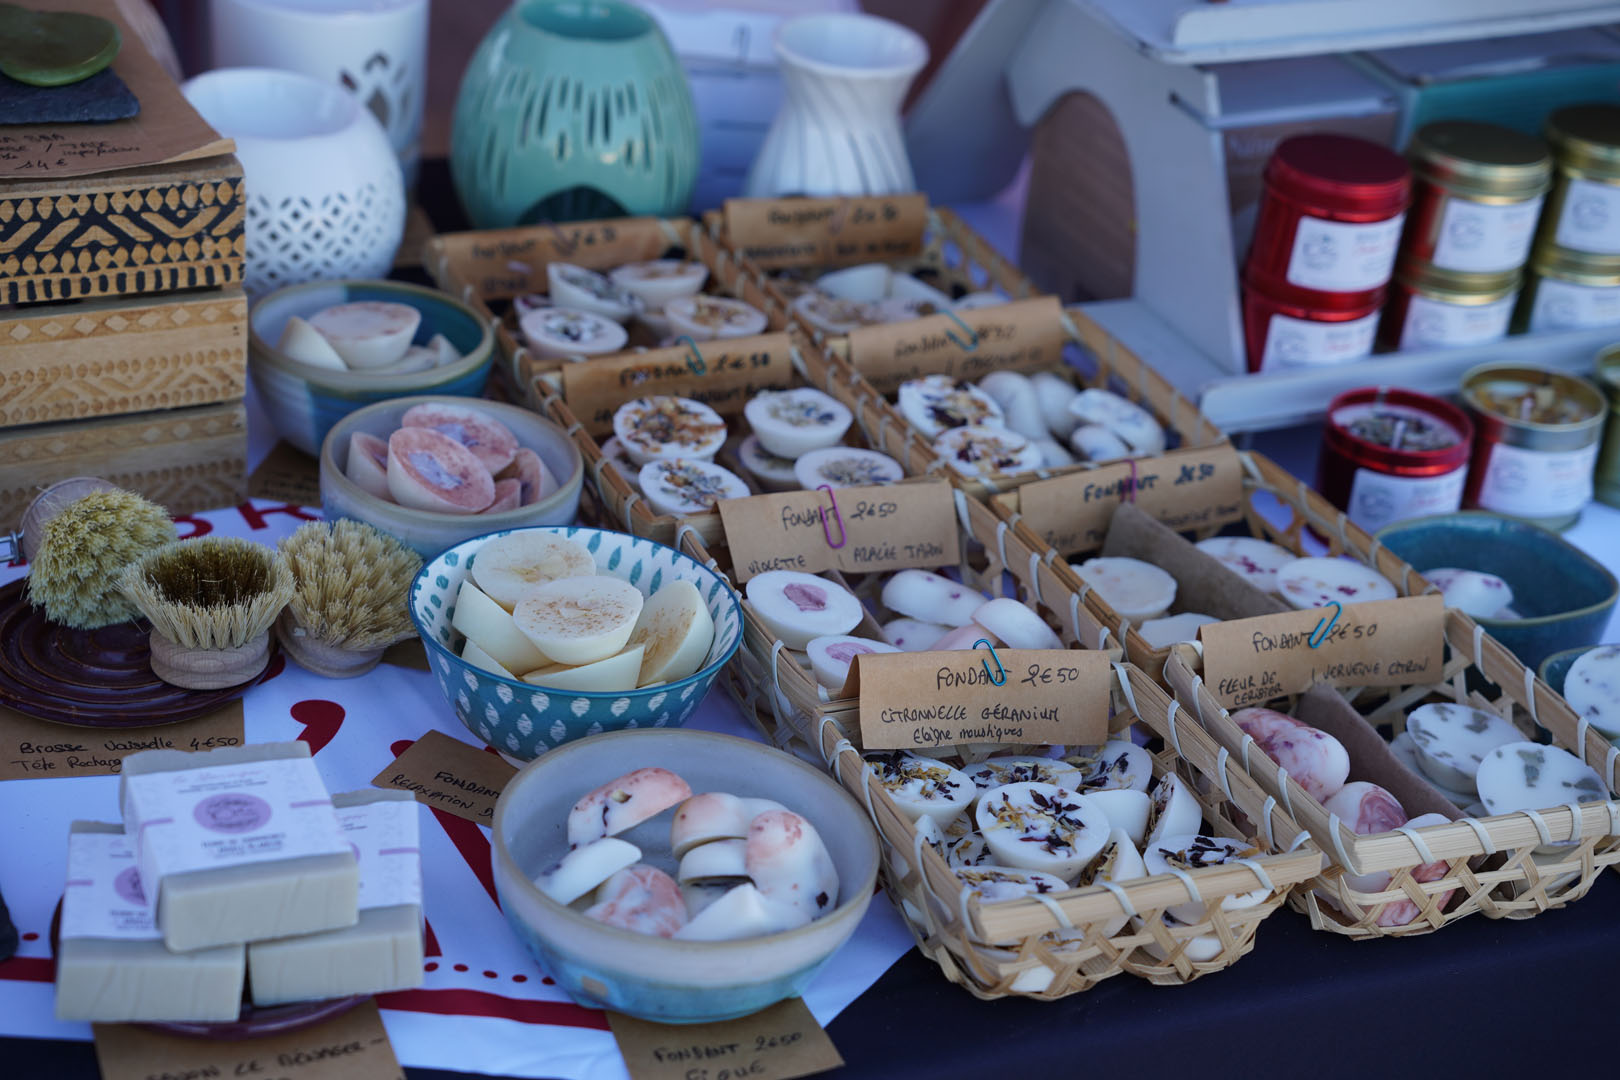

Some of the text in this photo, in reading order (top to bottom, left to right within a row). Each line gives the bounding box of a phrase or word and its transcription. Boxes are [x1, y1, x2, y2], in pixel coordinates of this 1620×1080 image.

[850, 501, 897, 520] 2€50
[1325, 623, 1378, 644] 2€50
[1021, 664, 1080, 687] 2€50
[1219, 672, 1277, 696] FLEUR DE
[20, 742, 88, 754] Brosse
[190, 737, 238, 750] 4€50
[755, 1031, 802, 1051] 2€50
